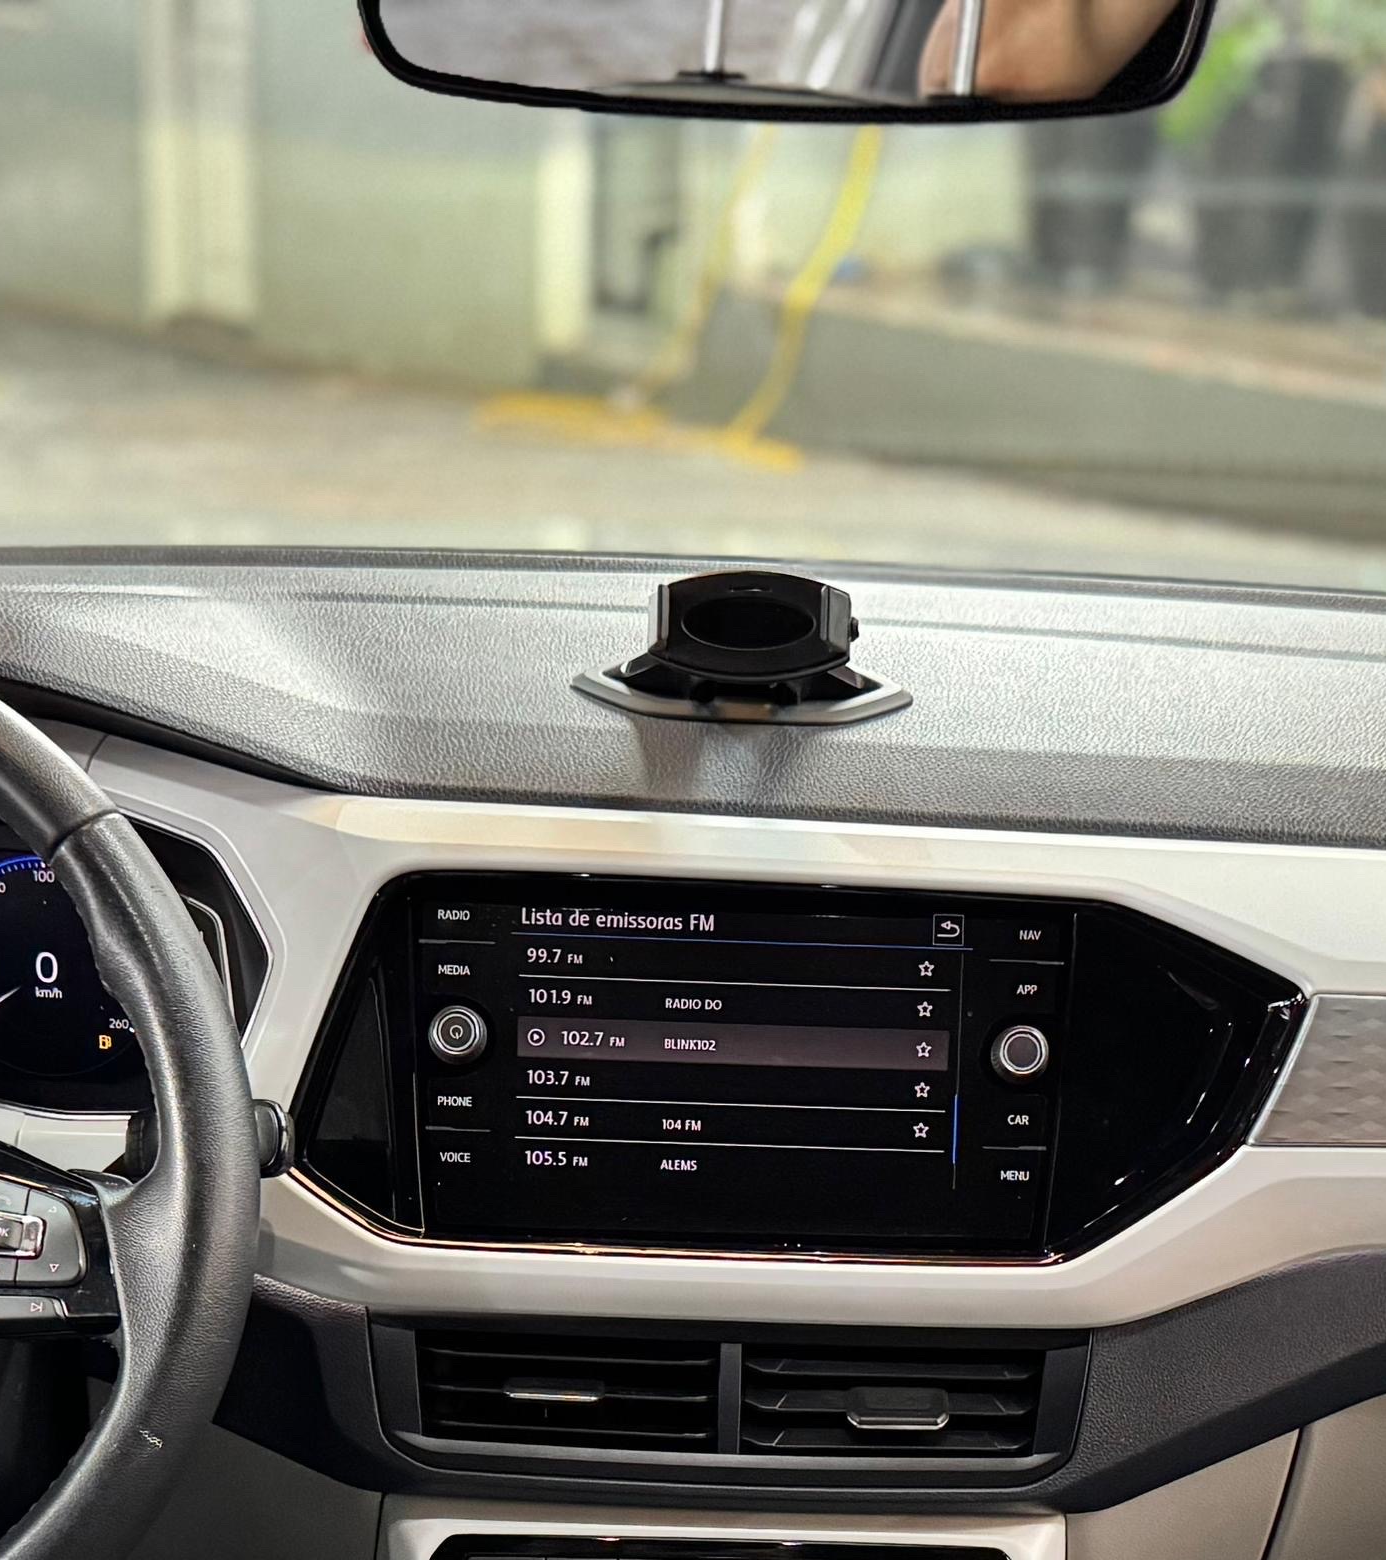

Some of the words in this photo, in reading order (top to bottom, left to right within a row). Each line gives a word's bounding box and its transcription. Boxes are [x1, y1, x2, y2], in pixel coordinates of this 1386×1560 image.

[33, 871, 55, 883] 100
[437, 909, 470, 921] RADIO
[521, 907, 562, 926] Lista
[569, 908, 589, 927] de
[596, 913, 683, 930] emissoras
[690, 914, 715, 931] FM
[1019, 930, 1041, 941] NAV
[527, 948, 561, 963] 99.7
[568, 954, 583, 964] FM
[35, 952, 58, 984] 0
[438, 964, 470, 976] MEDIA
[35, 987, 63, 999] km/h
[1016, 984, 1037, 995] APP
[529, 988, 571, 1004] 101.9
[577, 995, 592, 1005] FM
[666, 998, 701, 1010] RADIO
[705, 999, 722, 1010] DO
[109, 1019, 129, 1029] 260
[562, 1030, 604, 1047] 102.7
[610, 1037, 625, 1047] FM
[664, 1038, 716, 1051] BLINK102
[527, 1069, 569, 1085] 103.7
[575, 1076, 590, 1086] FM
[437, 1096, 472, 1107] PHONE
[526, 1110, 568, 1126] 104.7
[574, 1116, 589, 1126] FM
[662, 1119, 682, 1130] 104
[685, 1120, 701, 1131] FM
[1007, 1115, 1029, 1125] CAR
[440, 1152, 471, 1163] VOICE
[525, 1150, 567, 1166] 105.5
[573, 1156, 588, 1167] FM
[660, 1159, 698, 1171] ALEMS
[1000, 1170, 1030, 1181] MENU
